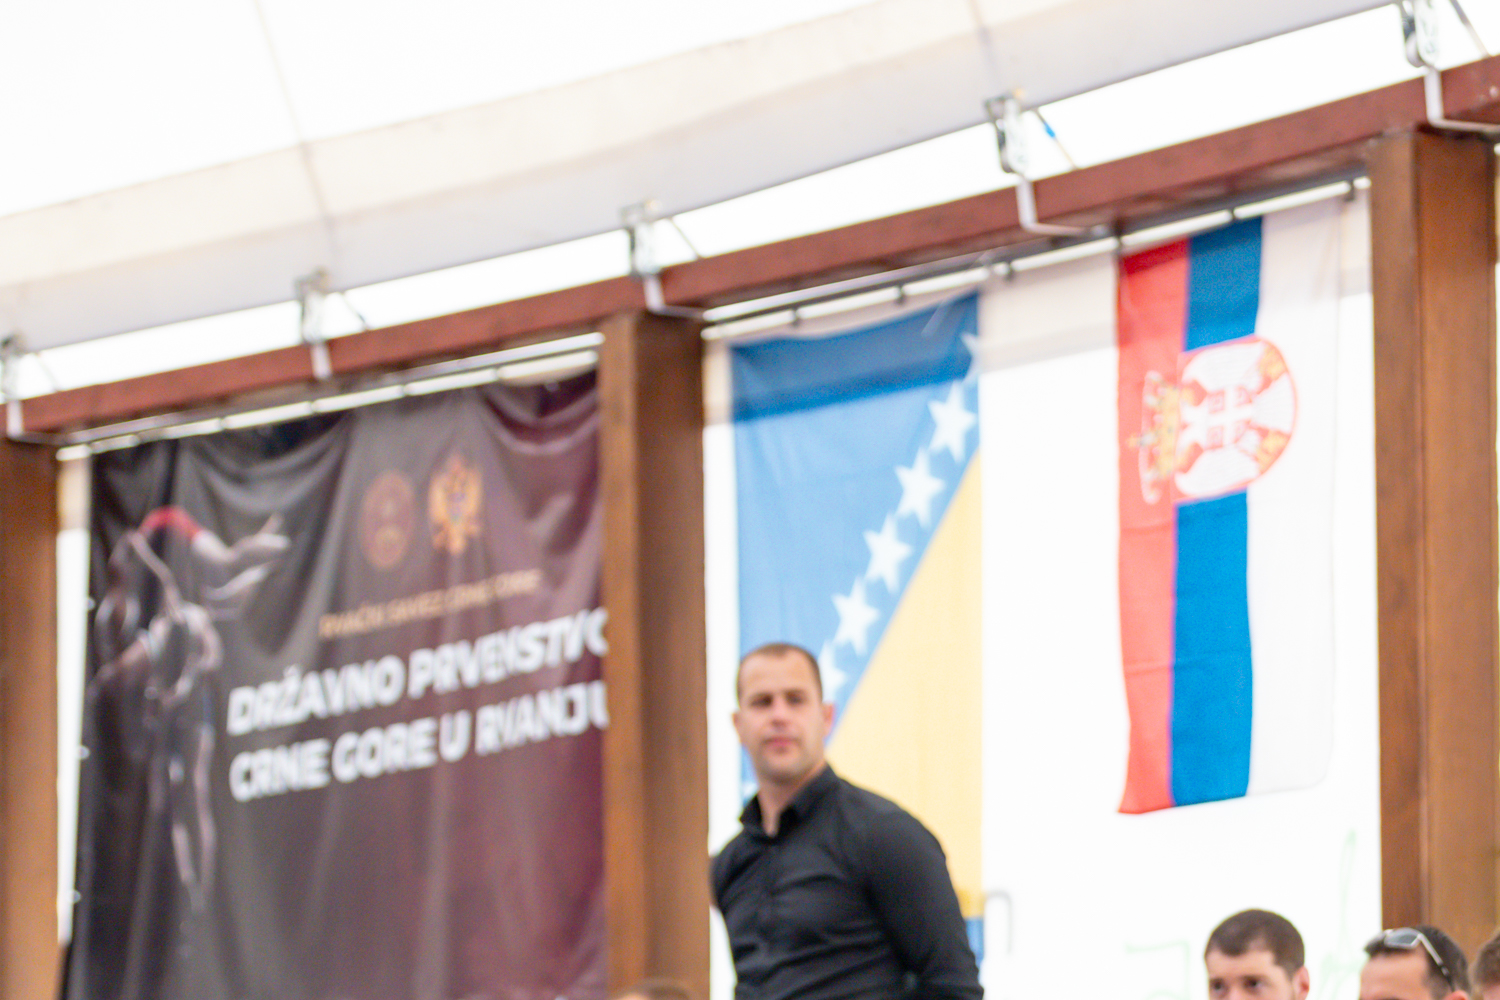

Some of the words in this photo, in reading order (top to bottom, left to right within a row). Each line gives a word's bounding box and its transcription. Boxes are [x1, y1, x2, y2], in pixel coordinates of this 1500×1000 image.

[227, 655, 405, 736] DRŽAVNO
[229, 737, 332, 803] CRNE
[332, 716, 438, 784] GORE
[439, 709, 472, 763] U
